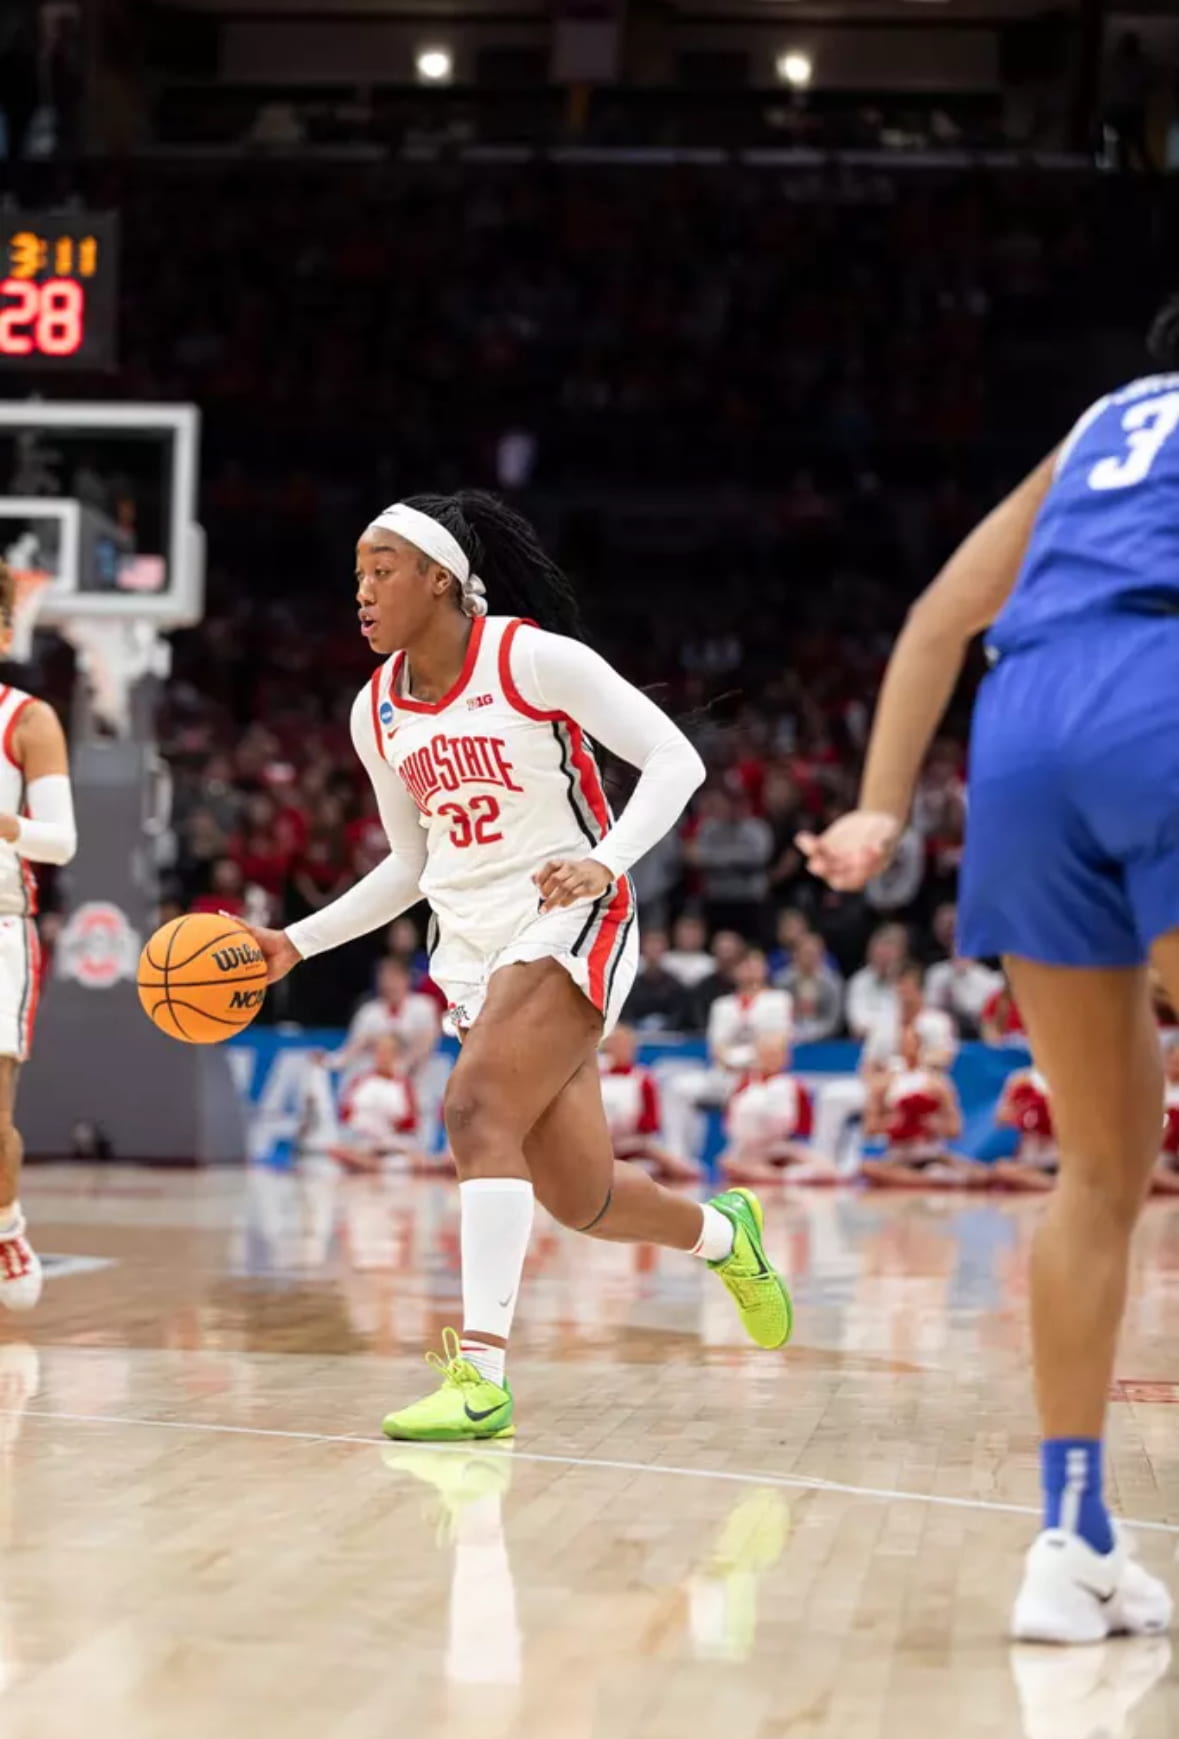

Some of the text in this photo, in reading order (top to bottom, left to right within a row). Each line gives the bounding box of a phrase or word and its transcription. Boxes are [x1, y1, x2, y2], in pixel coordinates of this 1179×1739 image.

[8, 231, 98, 278] 3:11
[0, 276, 84, 357] 28
[1087, 391, 1179, 491] 3
[431, 734, 524, 792] STATE
[437, 795, 503, 848] 32
